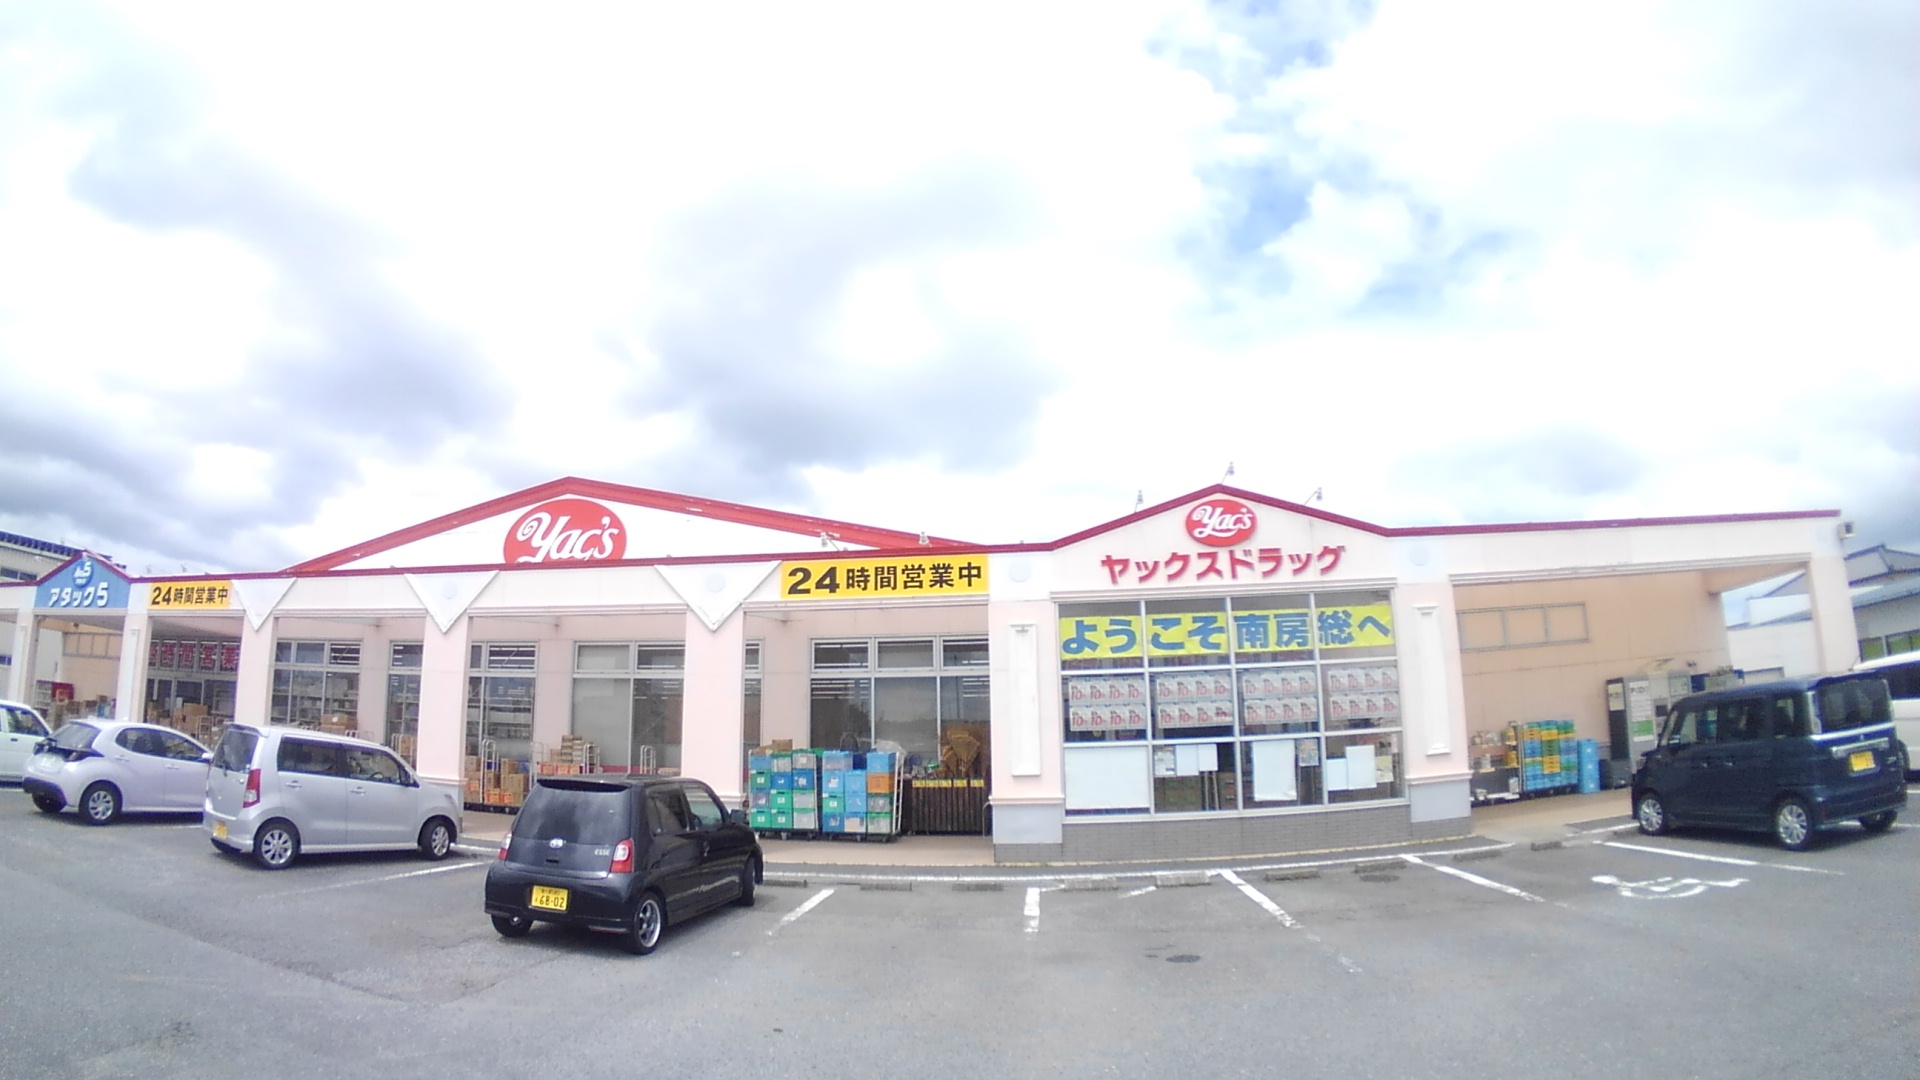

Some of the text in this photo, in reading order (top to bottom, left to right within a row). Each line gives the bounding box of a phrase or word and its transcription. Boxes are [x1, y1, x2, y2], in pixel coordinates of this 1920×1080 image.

[1191, 505, 1254, 538] Yac's
[787, 561, 982, 595] 24時間営業中
[1101, 545, 1346, 584] ヤックスドラッグ
[48, 582, 109, 608] アタック5
[151, 586, 228, 605] 24時間営業中
[1062, 609, 1391, 655] ようこそ南房総へ
